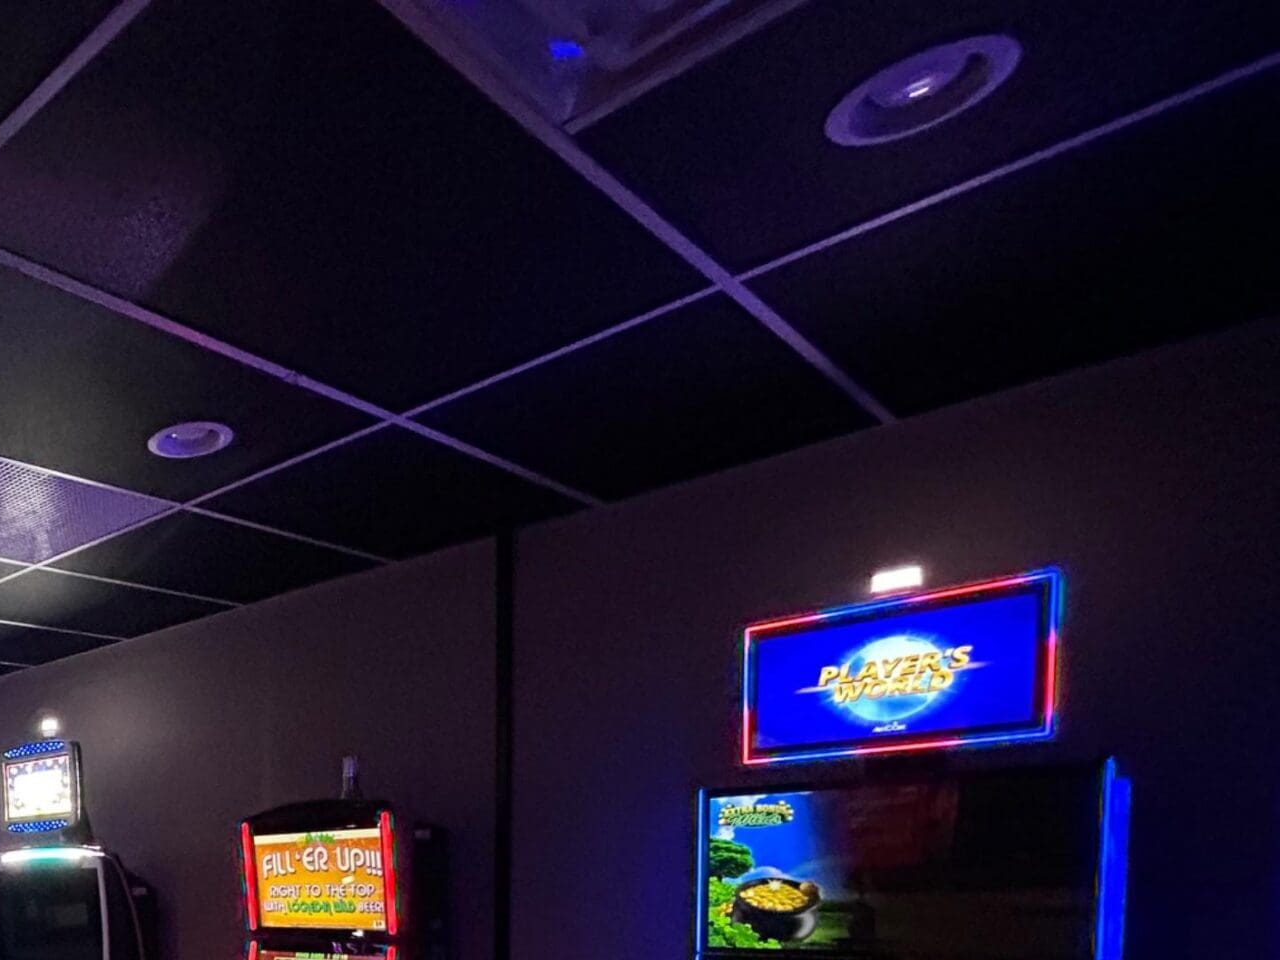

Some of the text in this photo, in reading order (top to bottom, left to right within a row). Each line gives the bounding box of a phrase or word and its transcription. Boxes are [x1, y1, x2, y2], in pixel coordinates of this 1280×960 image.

[820, 645, 973, 687] PLAYER'S
[834, 670, 953, 703] WORLD
[263, 850, 296, 879] FILL
[336, 846, 383, 876] UP!!!
[270, 884, 375, 898] RIGHT TO THE TOP
